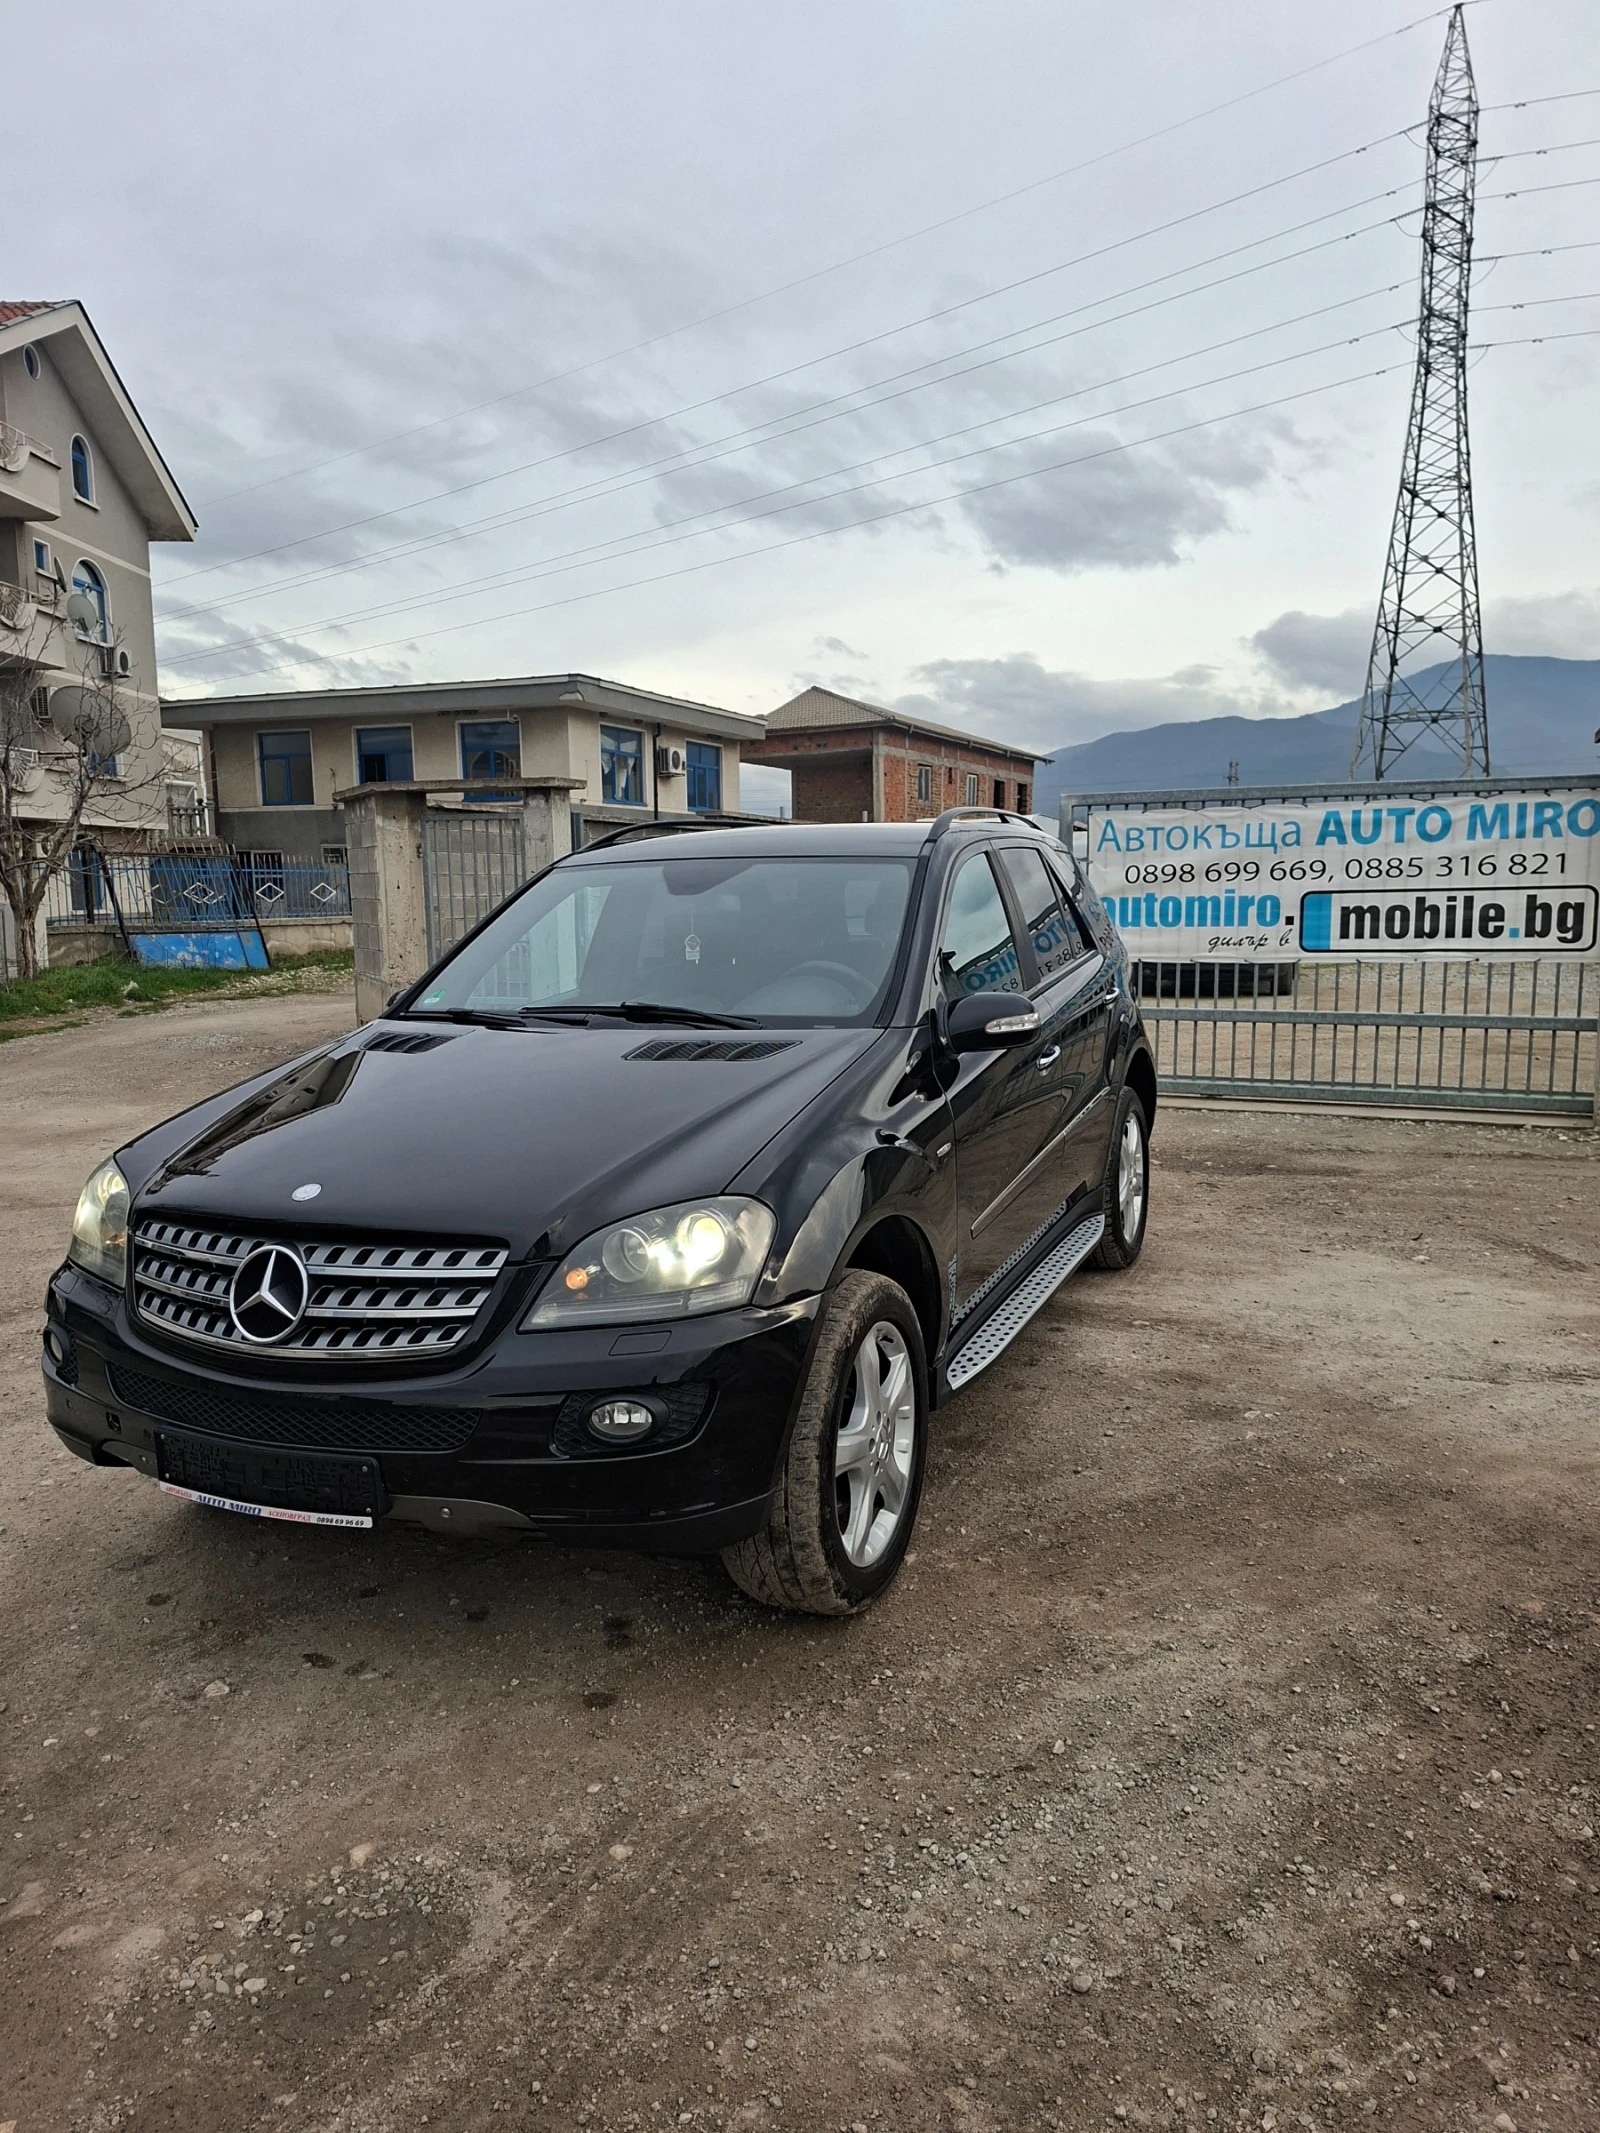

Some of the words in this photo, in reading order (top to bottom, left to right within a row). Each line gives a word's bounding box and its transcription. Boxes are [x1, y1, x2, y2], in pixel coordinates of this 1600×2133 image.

[1097, 819, 1301, 854] Автокъща
[1315, 805, 1452, 847] AUTO
[1466, 798, 1600, 841] MIRO
[1124, 862, 1196, 884] 0898
[1204, 861, 1260, 882] 699
[1269, 859, 1334, 883] 669,
[1344, 857, 1424, 879] 0885
[1435, 854, 1497, 877] 316
[1508, 852, 1567, 875] 821
[1339, 894, 1585, 944] mobile.bg
[1208, 934, 1269, 953] дилър
[196, 1494, 226, 1509] AUTO
[228, 1502, 262, 1515] MIRO
[267, 1510, 311, 1523] АСЕНОВГРАД
